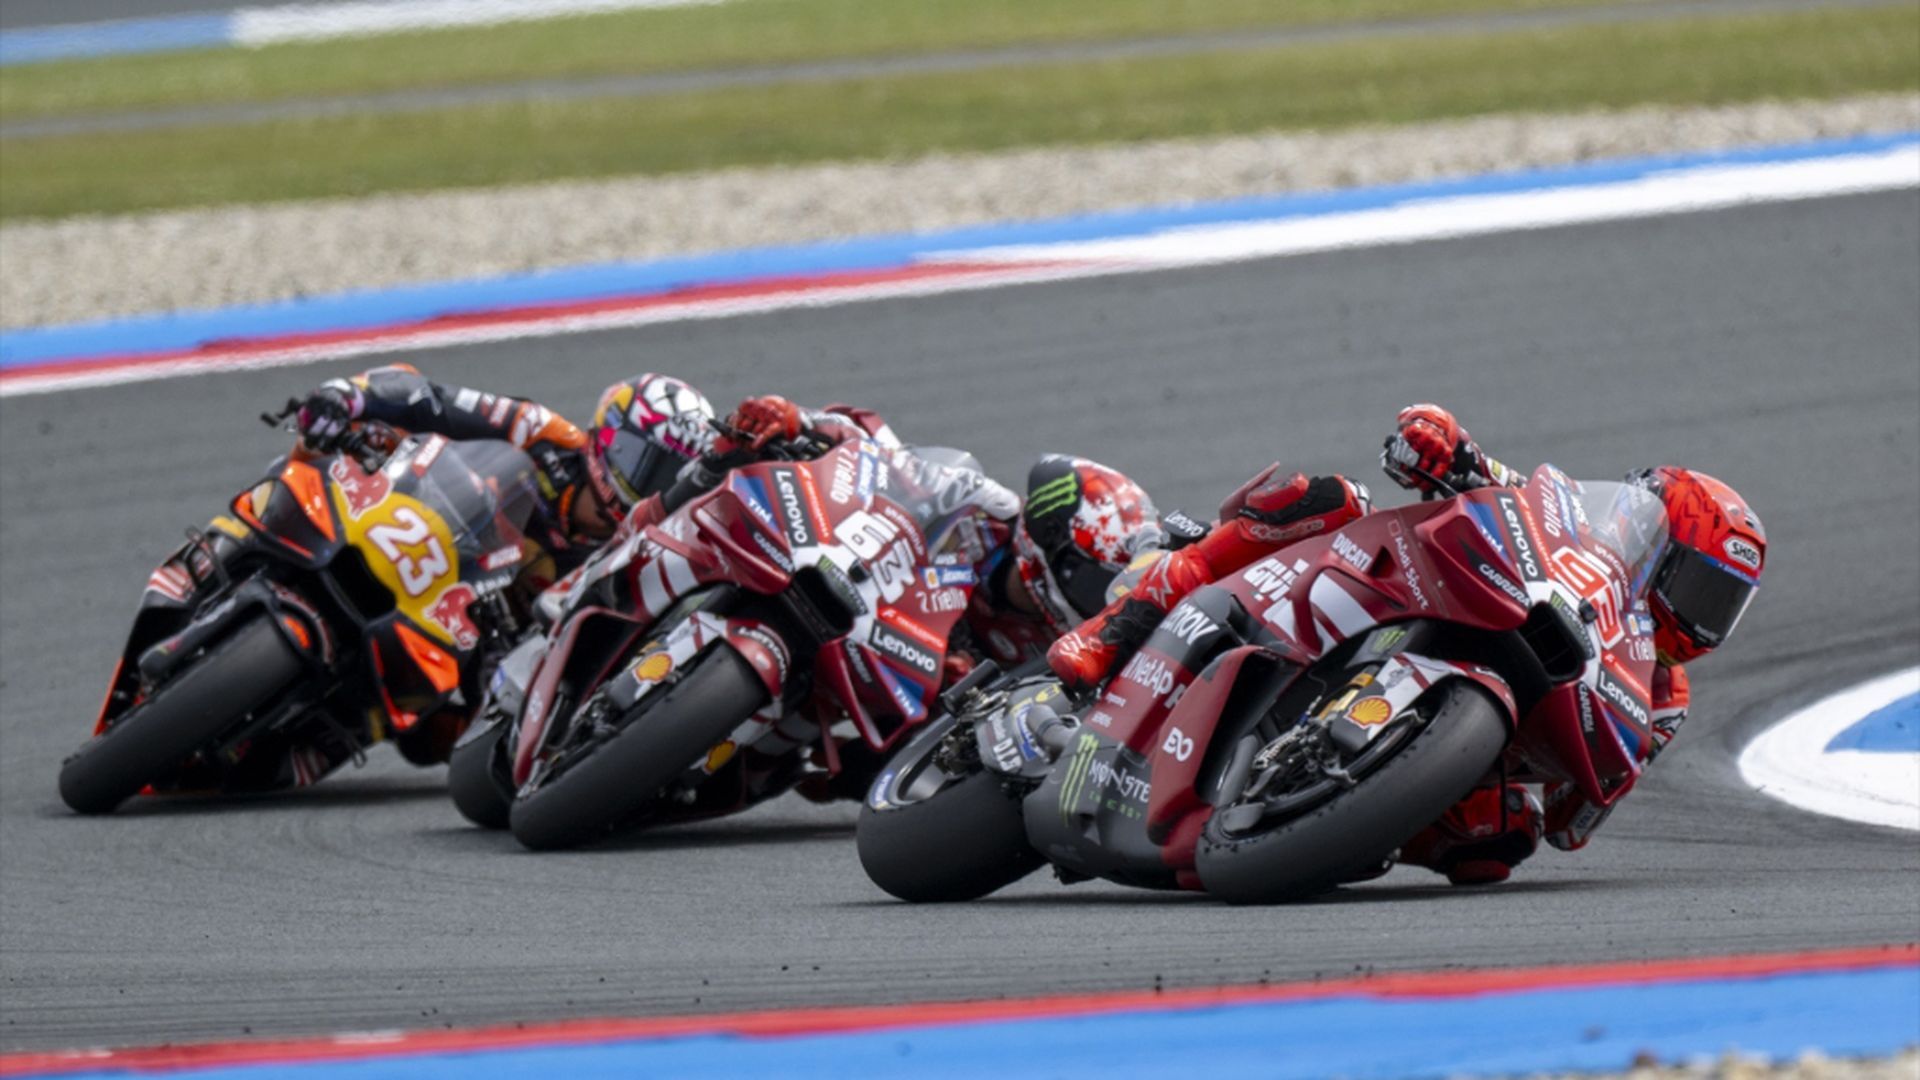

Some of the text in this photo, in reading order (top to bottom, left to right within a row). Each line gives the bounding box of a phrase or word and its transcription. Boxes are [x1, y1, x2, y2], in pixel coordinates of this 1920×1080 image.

[749, 498, 773, 523] TIM
[776, 471, 808, 543] Lenovo
[1164, 509, 1204, 537] Lenovo
[367, 508, 449, 596] 23
[834, 510, 915, 604] 63
[1332, 532, 1373, 572] DUCATI
[1500, 497, 1538, 577] Lenovo
[1732, 541, 1758, 566] SHOE
[1395, 536, 1430, 610] Audi Sport
[1478, 563, 1531, 607] CARRERA
[1551, 546, 1625, 650] 93
[873, 626, 936, 672] Lenovo
[1600, 671, 1648, 725] Lenovo
[1089, 759, 1152, 803] MONSTE
